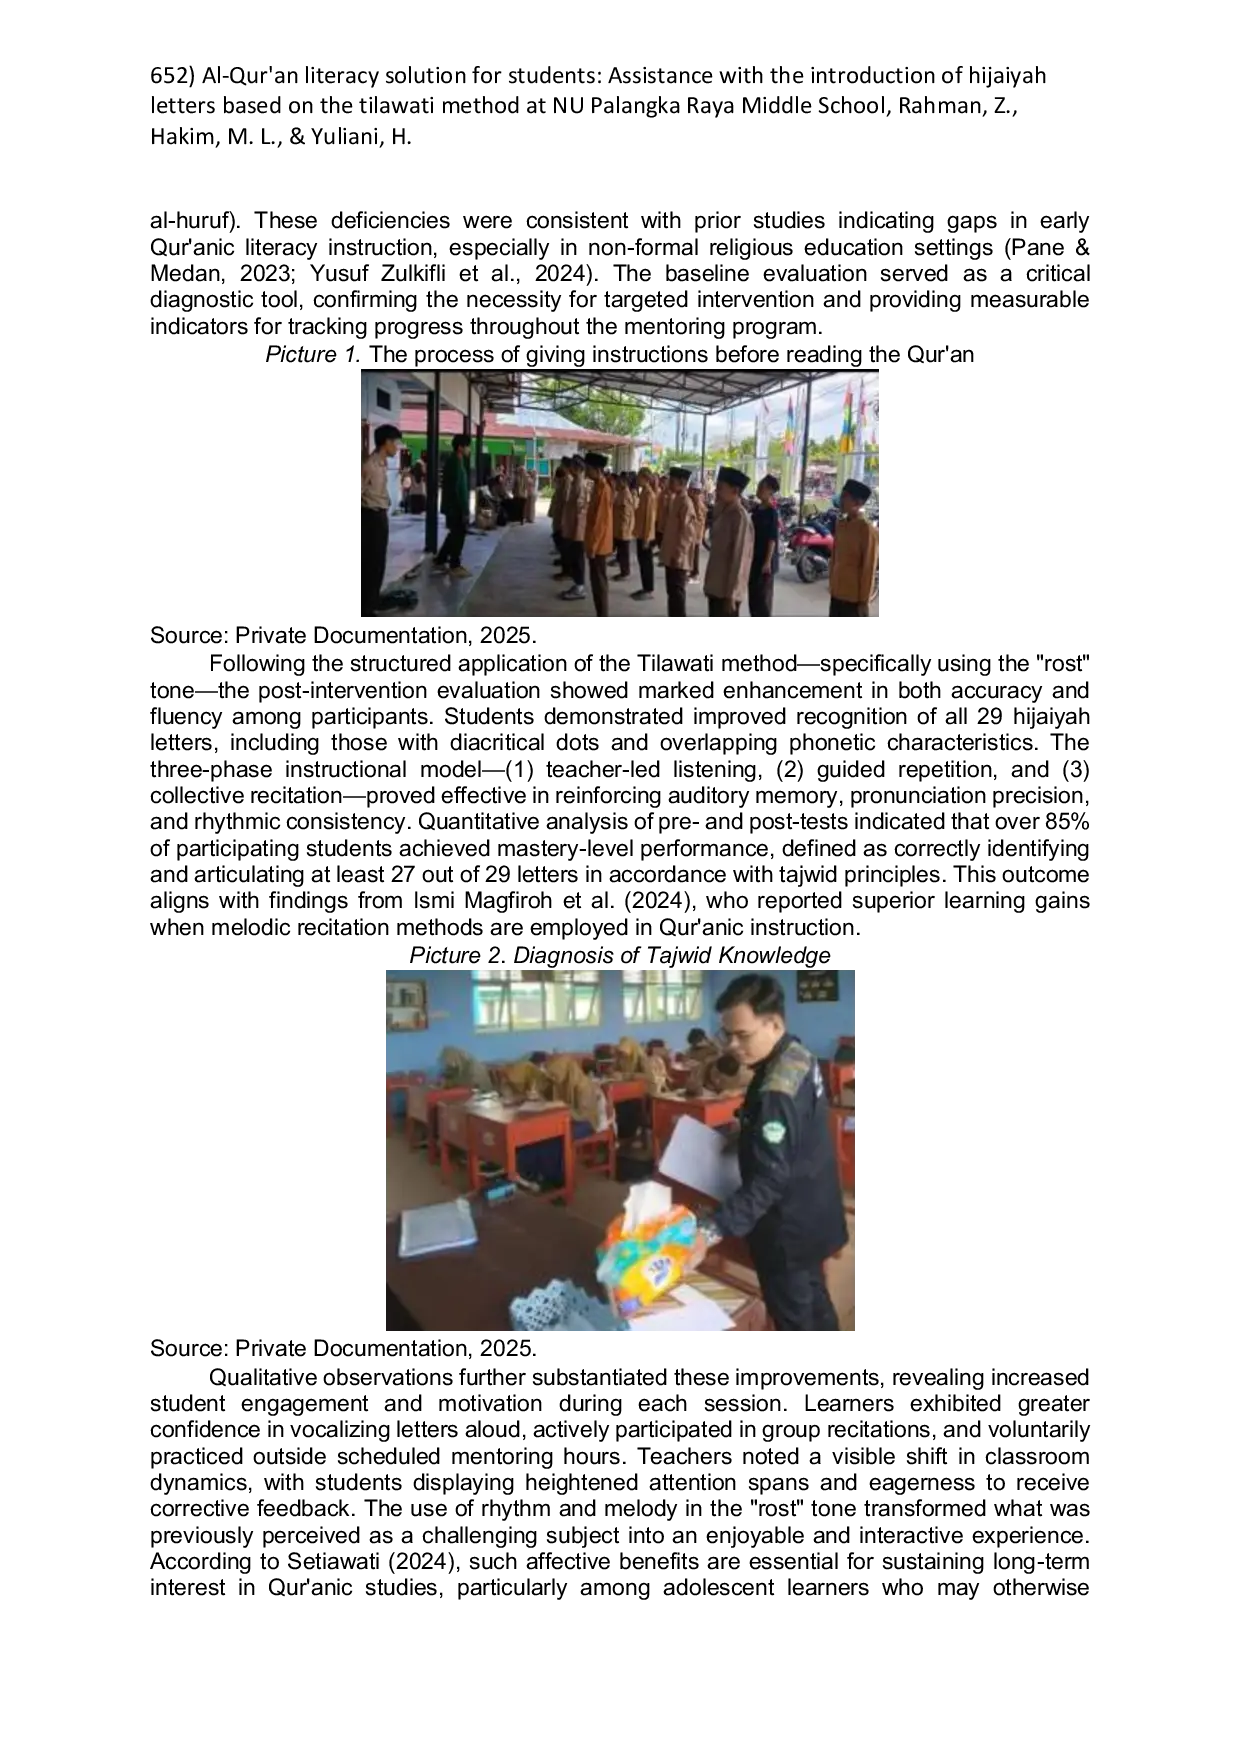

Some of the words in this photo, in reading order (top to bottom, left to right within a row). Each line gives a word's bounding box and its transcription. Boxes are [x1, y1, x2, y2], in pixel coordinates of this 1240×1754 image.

[150, 65, 195, 88] 652)
[201, 65, 298, 86] Al-Qur'an
[305, 65, 380, 89] literacy
[385, 65, 466, 84] solution
[471, 65, 502, 84] for
[508, 65, 602, 84] students:
[607, 66, 713, 84] Assistance
[719, 65, 763, 84] with
[769, 65, 804, 84] the
[810, 65, 935, 84] introduction
[941, 65, 964, 84] of
[969, 65, 1046, 89] hijaiyah
[151, 95, 216, 114] letters
[223, 95, 281, 114] based
[288, 100, 313, 114] on
[319, 95, 353, 114] the
[358, 95, 434, 114] tilawati
[442, 95, 519, 114] method
[526, 97, 547, 114] at
[553, 96, 584, 114] NU
[591, 95, 680, 119] Palangka
[687, 96, 734, 119] Raya
[742, 95, 812, 114] Middle
[818, 95, 892, 118] School,
[899, 95, 988, 118] Rahman,
[994, 96, 1018, 118] Z.,
[151, 126, 221, 149] Hakim,
[228, 127, 254, 145] M.
[261, 127, 283, 149] L.,
[289, 126, 306, 145] &
[310, 126, 385, 149] Yuliani,
[392, 127, 412, 145] H.
[150, 210, 241, 234] al-huruf).
[253, 210, 318, 229] These
[331, 210, 451, 229] deficiencies
[462, 215, 513, 229] were
[526, 210, 629, 229] consistent
[640, 210, 681, 229] with
[694, 210, 742, 234] prior
[753, 210, 826, 229] studies
[838, 210, 934, 234] indicating
[947, 215, 998, 234] gaps
[1010, 210, 1027, 229] in
[1040, 210, 1090, 234] early
[150, 289, 254, 313] diagnostic
[260, 289, 303, 311] tool,
[313, 289, 417, 313] confirming
[425, 289, 459, 308] the
[466, 289, 562, 313] necessity
[568, 289, 598, 308] for
[603, 289, 688, 313] targeted
[697, 289, 814, 308] intervention
[823, 289, 861, 308] and
[869, 289, 961, 313] providing
[970, 289, 1090, 308] measurable
[265, 344, 337, 363] Picture
[346, 344, 360, 363] 1.
[368, 344, 408, 363] The
[414, 349, 495, 368] process
[501, 344, 521, 363] of
[526, 344, 585, 368] giving
[592, 344, 709, 363] instructions
[715, 344, 780, 363] before
[786, 344, 862, 368] reading
[868, 344, 901, 363] the
[907, 344, 974, 364] Qur'an
[150, 625, 228, 644] Source:
[236, 625, 307, 644] Private
[314, 625, 472, 647] Documentation,
[480, 625, 537, 644] 2025.
[210, 653, 305, 677] Following
[311, 653, 344, 672] the
[350, 653, 451, 672] structured
[458, 653, 567, 677] application
[574, 653, 594, 672] of
[598, 653, 631, 672] the
[636, 653, 714, 672] Tilawati
[937, 653, 991, 677] using
[997, 653, 1030, 672] the
[1036, 653, 1090, 672] "rost"
[149, 759, 273, 783] three-phase
[285, 759, 407, 778] instructional
[545, 759, 660, 778] teacher-led
[673, 759, 762, 783] listening,
[776, 759, 804, 783] (2)
[817, 759, 885, 783] guided
[898, 759, 997, 783] repetition,
[1011, 759, 1049, 778] and
[1062, 759, 1090, 783] (3)
[150, 838, 171, 857] of
[176, 838, 299, 862] participating
[306, 838, 393, 857] students
[399, 838, 490, 857] achieved
[497, 838, 634, 862] mastery-level
[640, 838, 774, 862] performance,
[782, 838, 856, 857] defined
[863, 843, 888, 857] as
[894, 838, 981, 862] correctly
[987, 838, 1089, 862] identifying
[409, 945, 481, 964] Picture
[487, 945, 506, 964] 2.
[513, 945, 614, 969] Diagnosis
[620, 945, 642, 964] of
[647, 945, 713, 969] Tajwid
[718, 945, 831, 969] Knowledge
[150, 1338, 228, 1357] Source:
[236, 1338, 307, 1357] Private
[314, 1338, 472, 1360] Documentation,
[480, 1338, 537, 1357] 2025.
[209, 1367, 318, 1387] Qualitative
[323, 1367, 454, 1386] observations
[458, 1367, 527, 1386] further
[532, 1367, 667, 1386] substantiated
[673, 1367, 730, 1386] these
[735, 1367, 884, 1391] improvements,
[892, 1367, 984, 1391] revealing
[991, 1367, 1089, 1386] increased
[150, 1446, 243, 1470] practiced
[253, 1446, 327, 1465] outside
[337, 1446, 440, 1465] scheduled
[451, 1446, 553, 1470] mentoring
[563, 1446, 627, 1465] hours.
[636, 1446, 733, 1465] Teachers
[742, 1446, 799, 1465] noted
[809, 1451, 822, 1465] a
[831, 1446, 896, 1465] visible
[906, 1446, 948, 1465] shift
[958, 1446, 975, 1465] in
[985, 1446, 1090, 1465] classroom
[149, 1551, 251, 1575] According
[259, 1552, 280, 1570] to
[287, 1551, 380, 1570] Setiawati
[388, 1551, 460, 1575] (2024),
[469, 1551, 517, 1570] such
[526, 1551, 611, 1570] affective
[619, 1551, 700, 1570] benefits
[707, 1556, 741, 1570] are
[749, 1551, 839, 1570] essential
[846, 1551, 875, 1570] for
[882, 1551, 984, 1575] sustaining
[993, 1551, 1090, 1575] long-term
[150, 1577, 226, 1596] interest
[238, 1577, 255, 1596] in
[268, 1577, 353, 1597] Qur'anic
[365, 1577, 443, 1599] studies,
[457, 1577, 568, 1601] particularly
[580, 1582, 650, 1601] among
[663, 1577, 775, 1596] adolescent
[787, 1577, 870, 1596] learners
[881, 1577, 924, 1596] who
[937, 1582, 980, 1601] may
[993, 1577, 1090, 1596] otherwise
